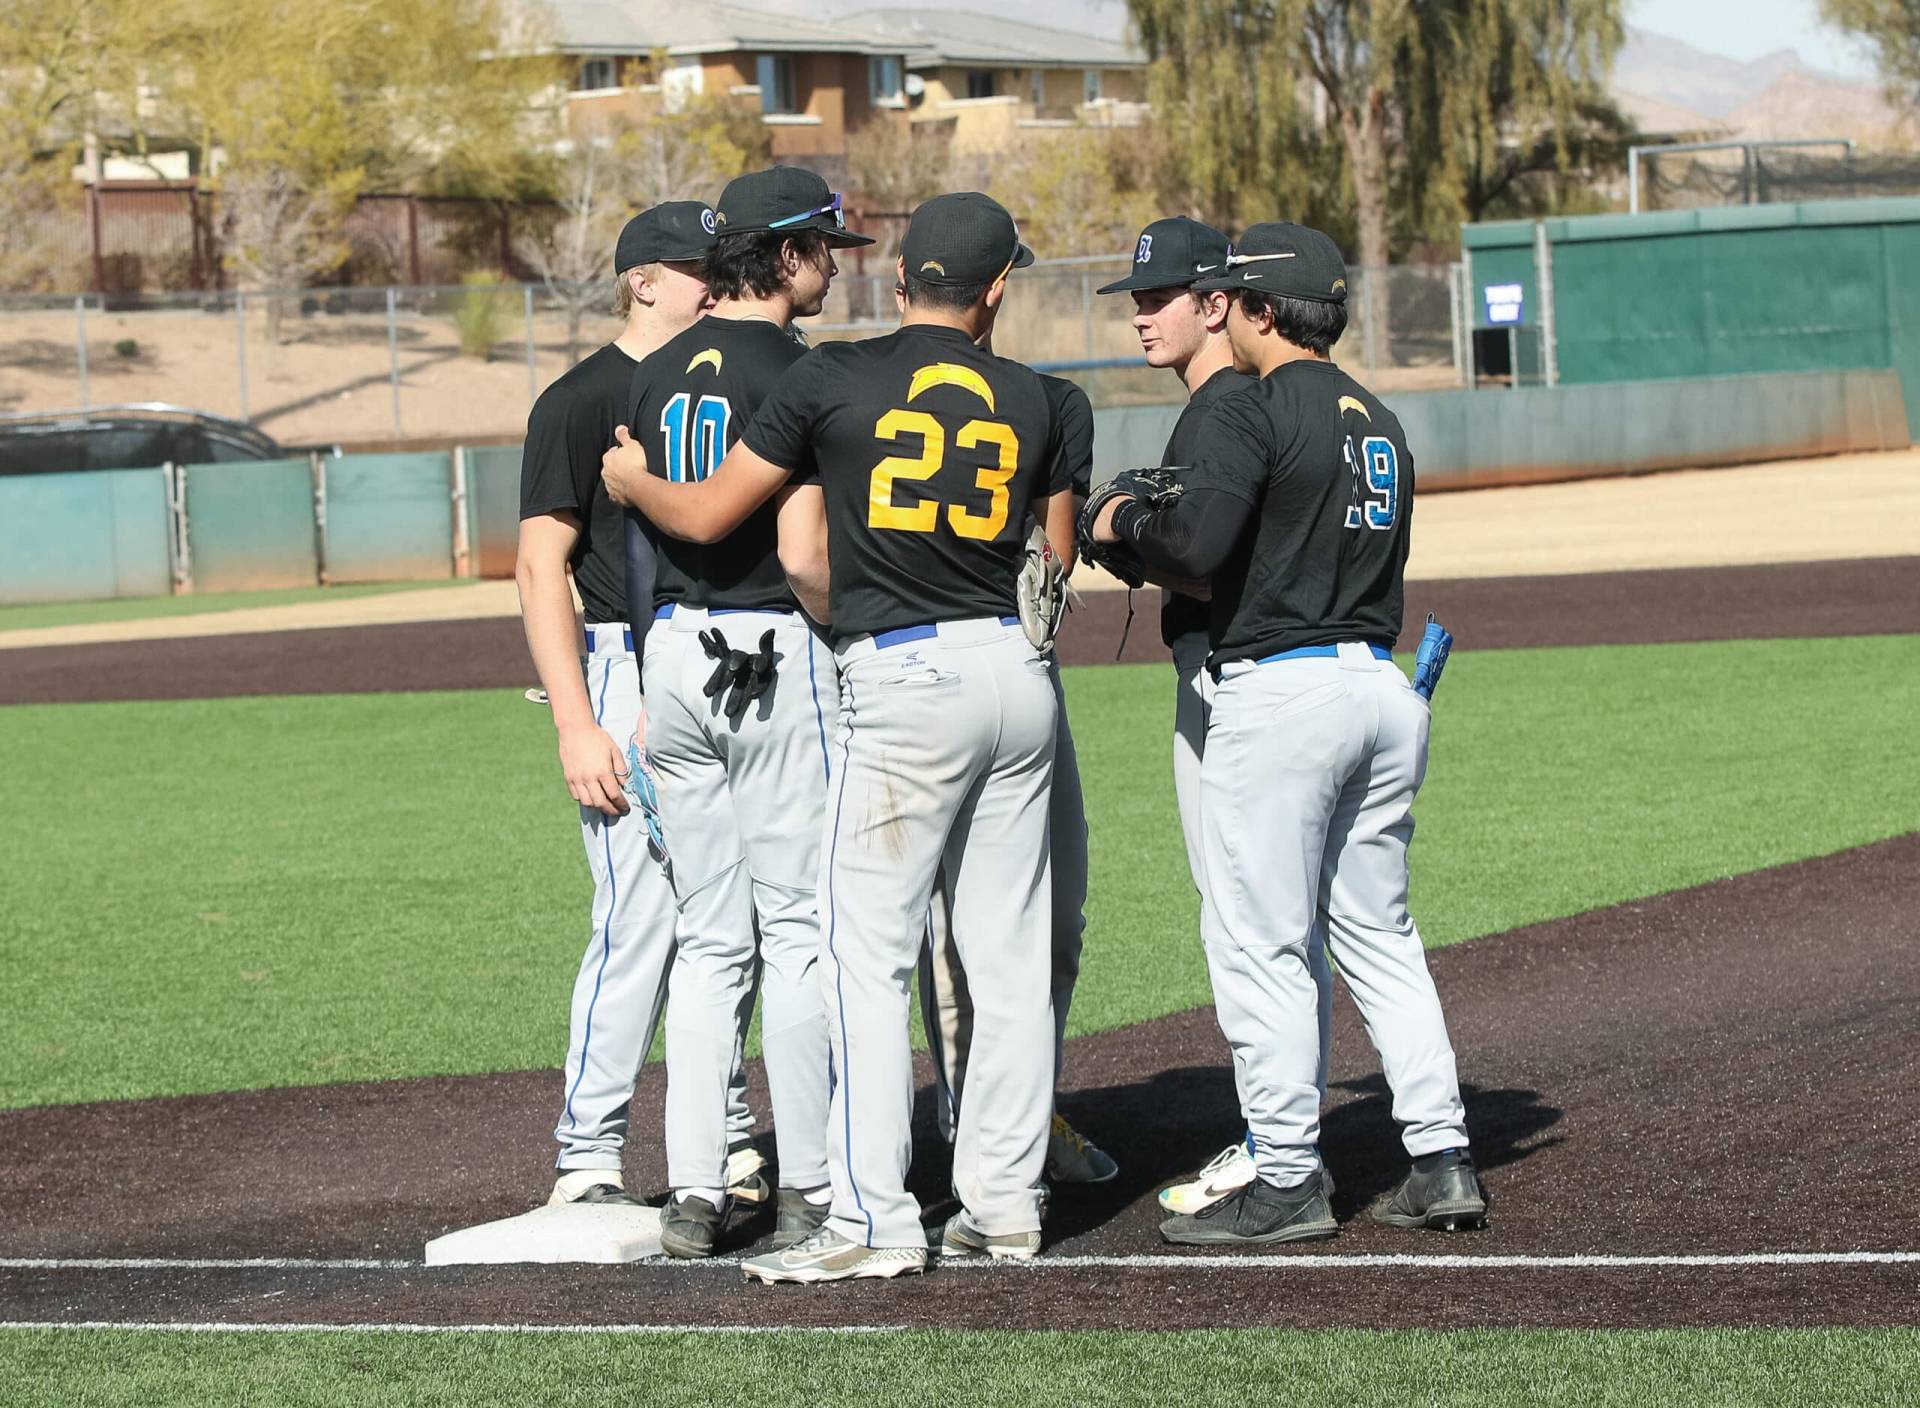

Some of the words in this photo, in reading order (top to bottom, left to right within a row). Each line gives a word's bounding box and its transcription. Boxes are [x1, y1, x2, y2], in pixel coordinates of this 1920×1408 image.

[660, 392, 732, 483] 10
[868, 409, 1020, 542] 23
[1343, 435, 1399, 530] 19
